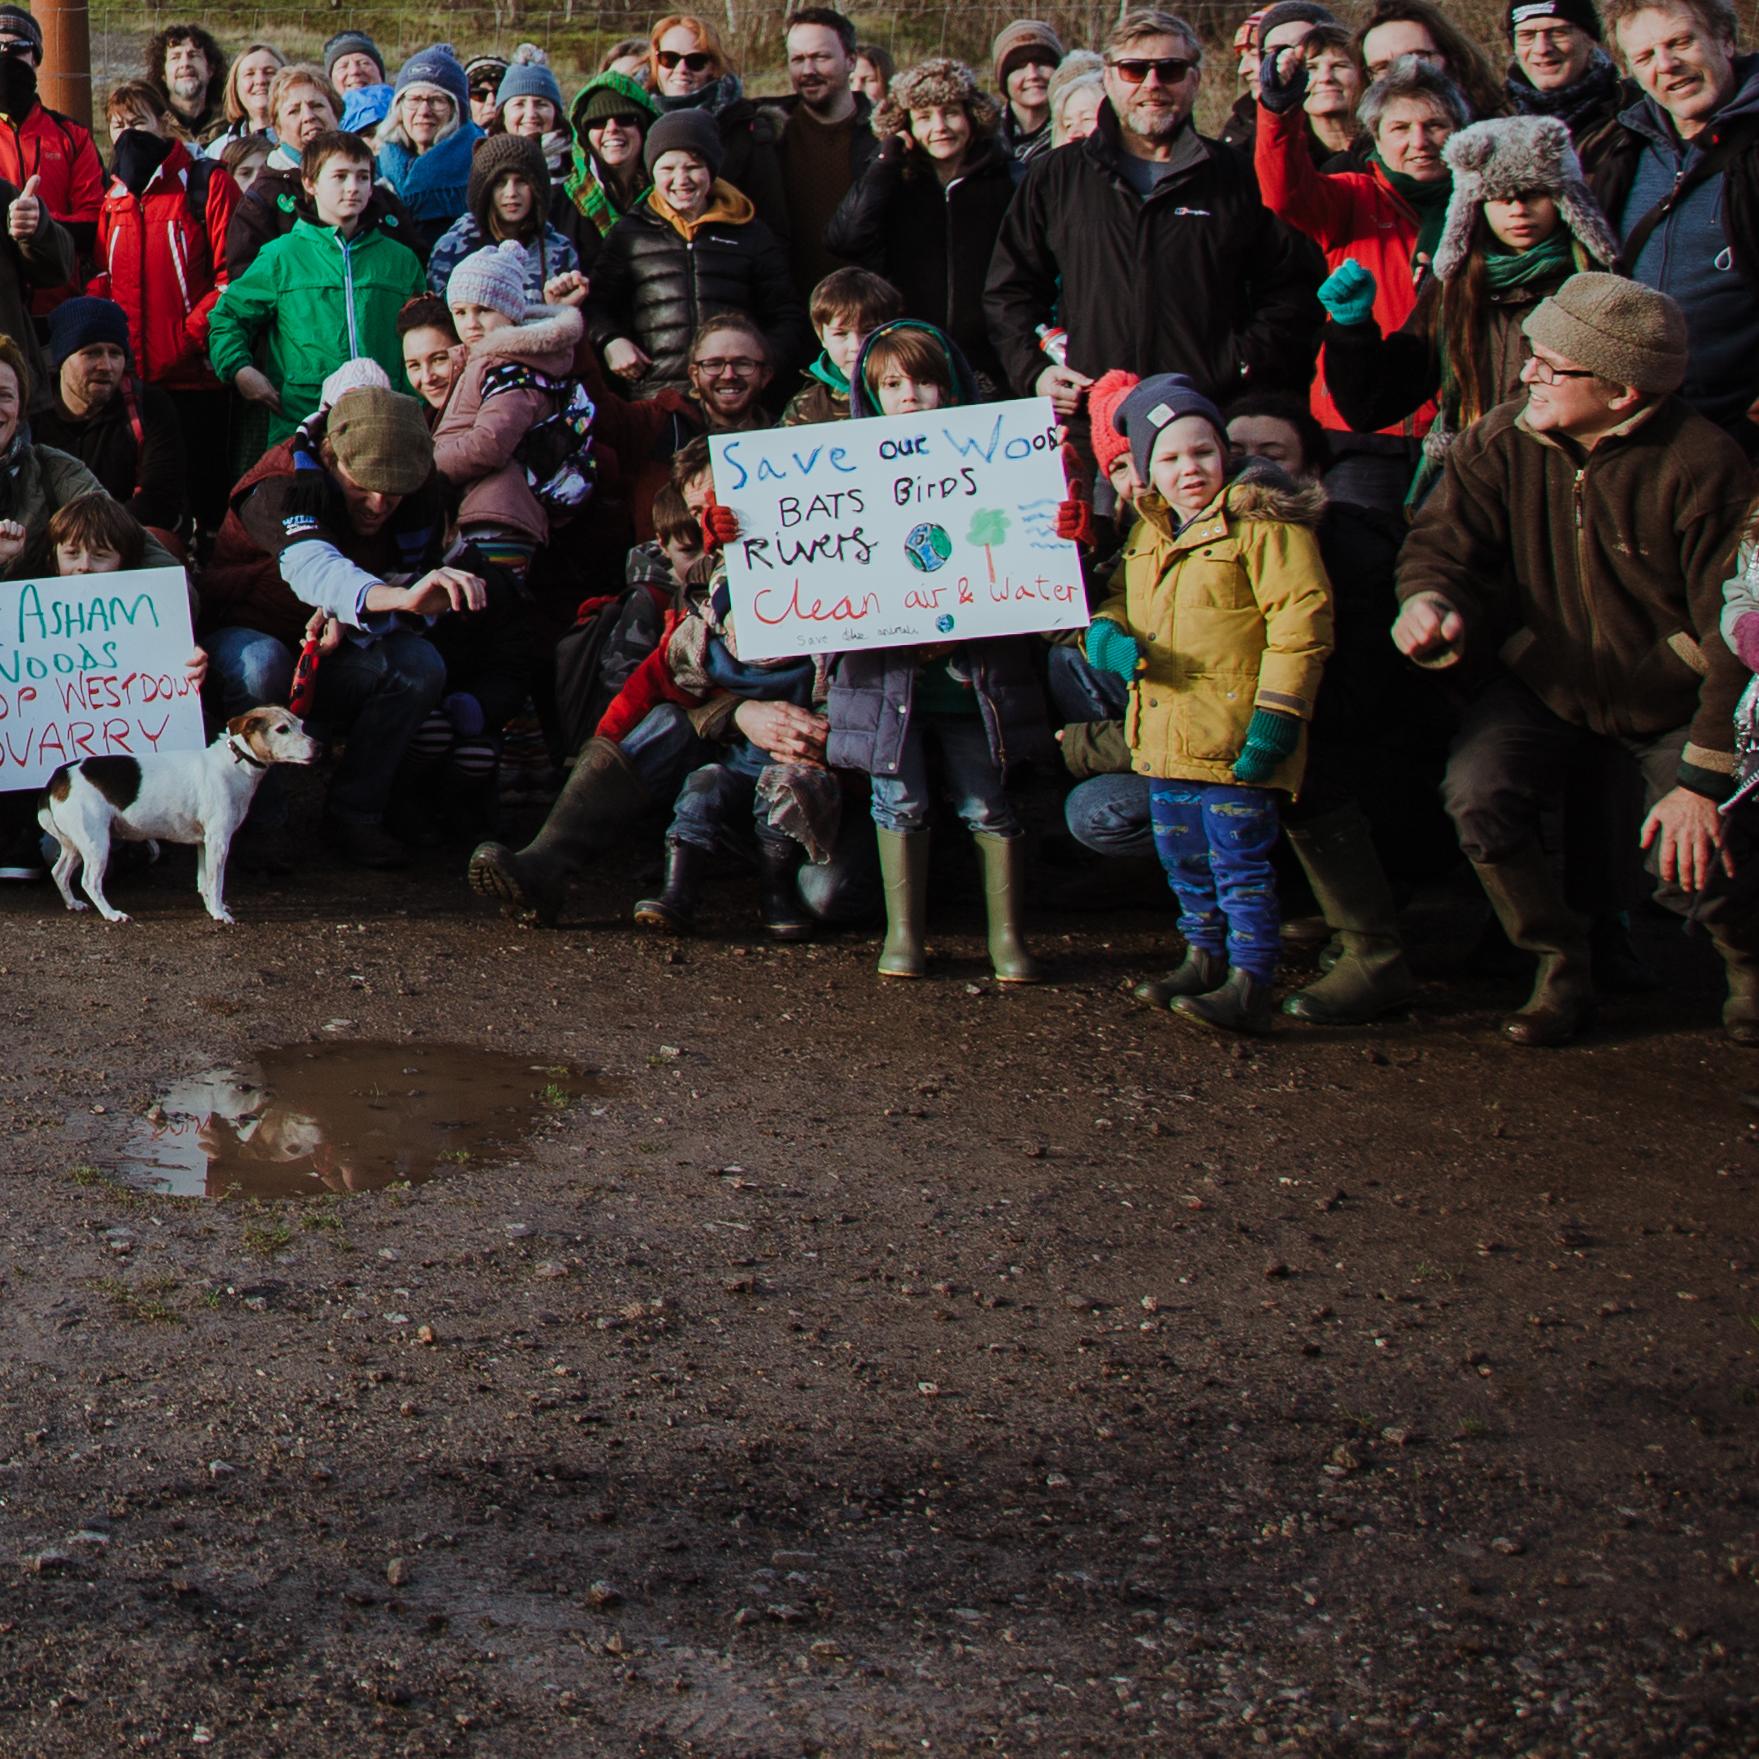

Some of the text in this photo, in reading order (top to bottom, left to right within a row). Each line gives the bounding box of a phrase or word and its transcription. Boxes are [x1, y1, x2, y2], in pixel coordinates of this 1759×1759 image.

[723, 442, 857, 491] Save
[779, 489, 864, 527] BATS
[19, 584, 159, 643] ASHAM
[753, 578, 881, 625] Clean
[904, 583, 948, 610] air
[957, 576, 974, 606] &
